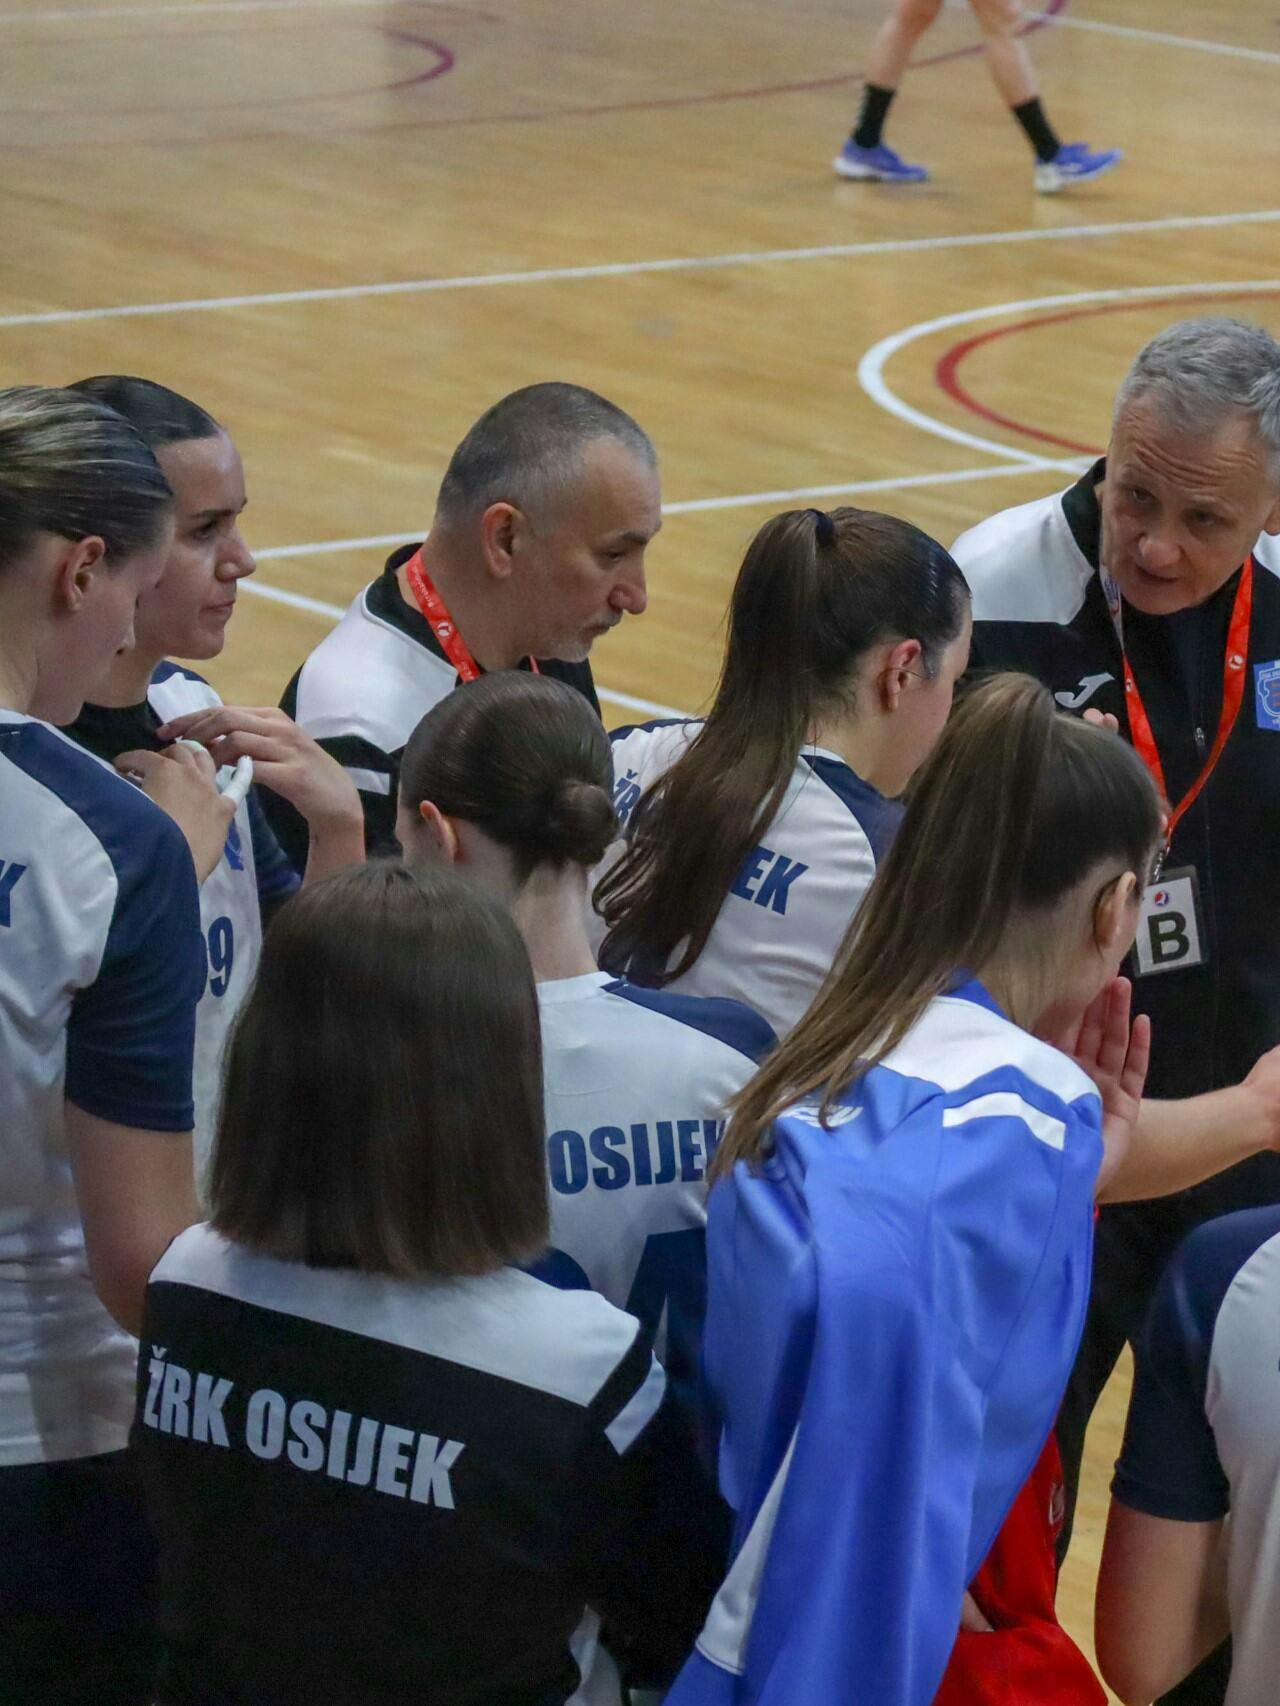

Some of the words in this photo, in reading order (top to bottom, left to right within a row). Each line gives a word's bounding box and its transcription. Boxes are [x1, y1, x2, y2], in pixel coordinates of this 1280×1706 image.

[1146, 910, 1191, 966] B
[144, 1344, 235, 1448] ŽRK
[245, 1388, 467, 1510] OSIJEK
